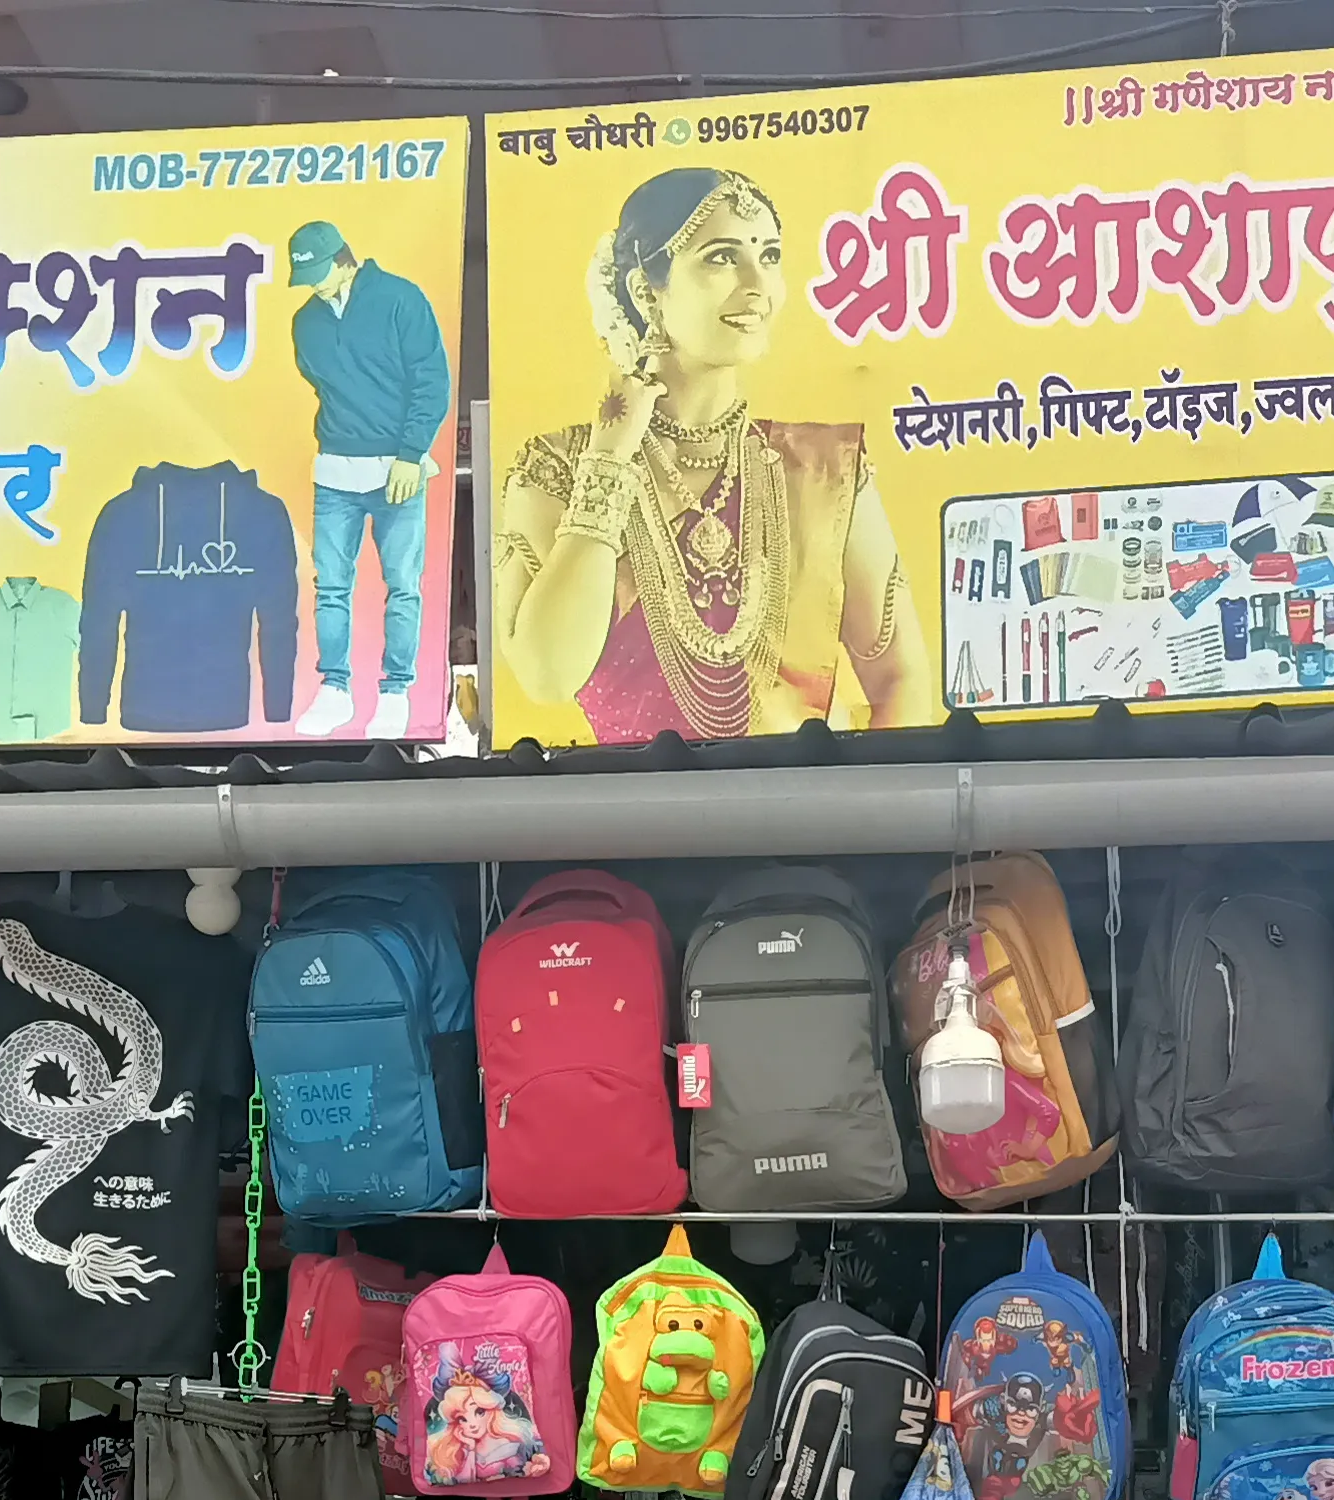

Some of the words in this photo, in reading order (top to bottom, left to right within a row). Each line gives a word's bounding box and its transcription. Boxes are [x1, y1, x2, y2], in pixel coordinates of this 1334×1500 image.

[1154, 71, 1294, 114] गणेशाय
[499, 128, 558, 165] बाबु
[567, 115, 657, 152] चौधरी
[697, 106, 871, 146] 9967540307
[93, 141, 445, 192] MOB-7727921167
[813, 172, 961, 338] श्री
[757, 939, 796, 954] PUMA
[539, 955, 593, 969] WILDCRAFT
[299, 973, 331, 986] adidas
[682, 1055, 696, 1094] PUMA
[297, 1081, 353, 1102] GAME
[300, 1106, 352, 1127] OVER
[754, 1152, 828, 1174] PUMA
[995, 1311, 1045, 1330] SQUAD
[473, 1341, 501, 1361] Little
[790, 1445, 811, 1499] AMERICAN
[796, 1449, 817, 1500] TOURISTER
